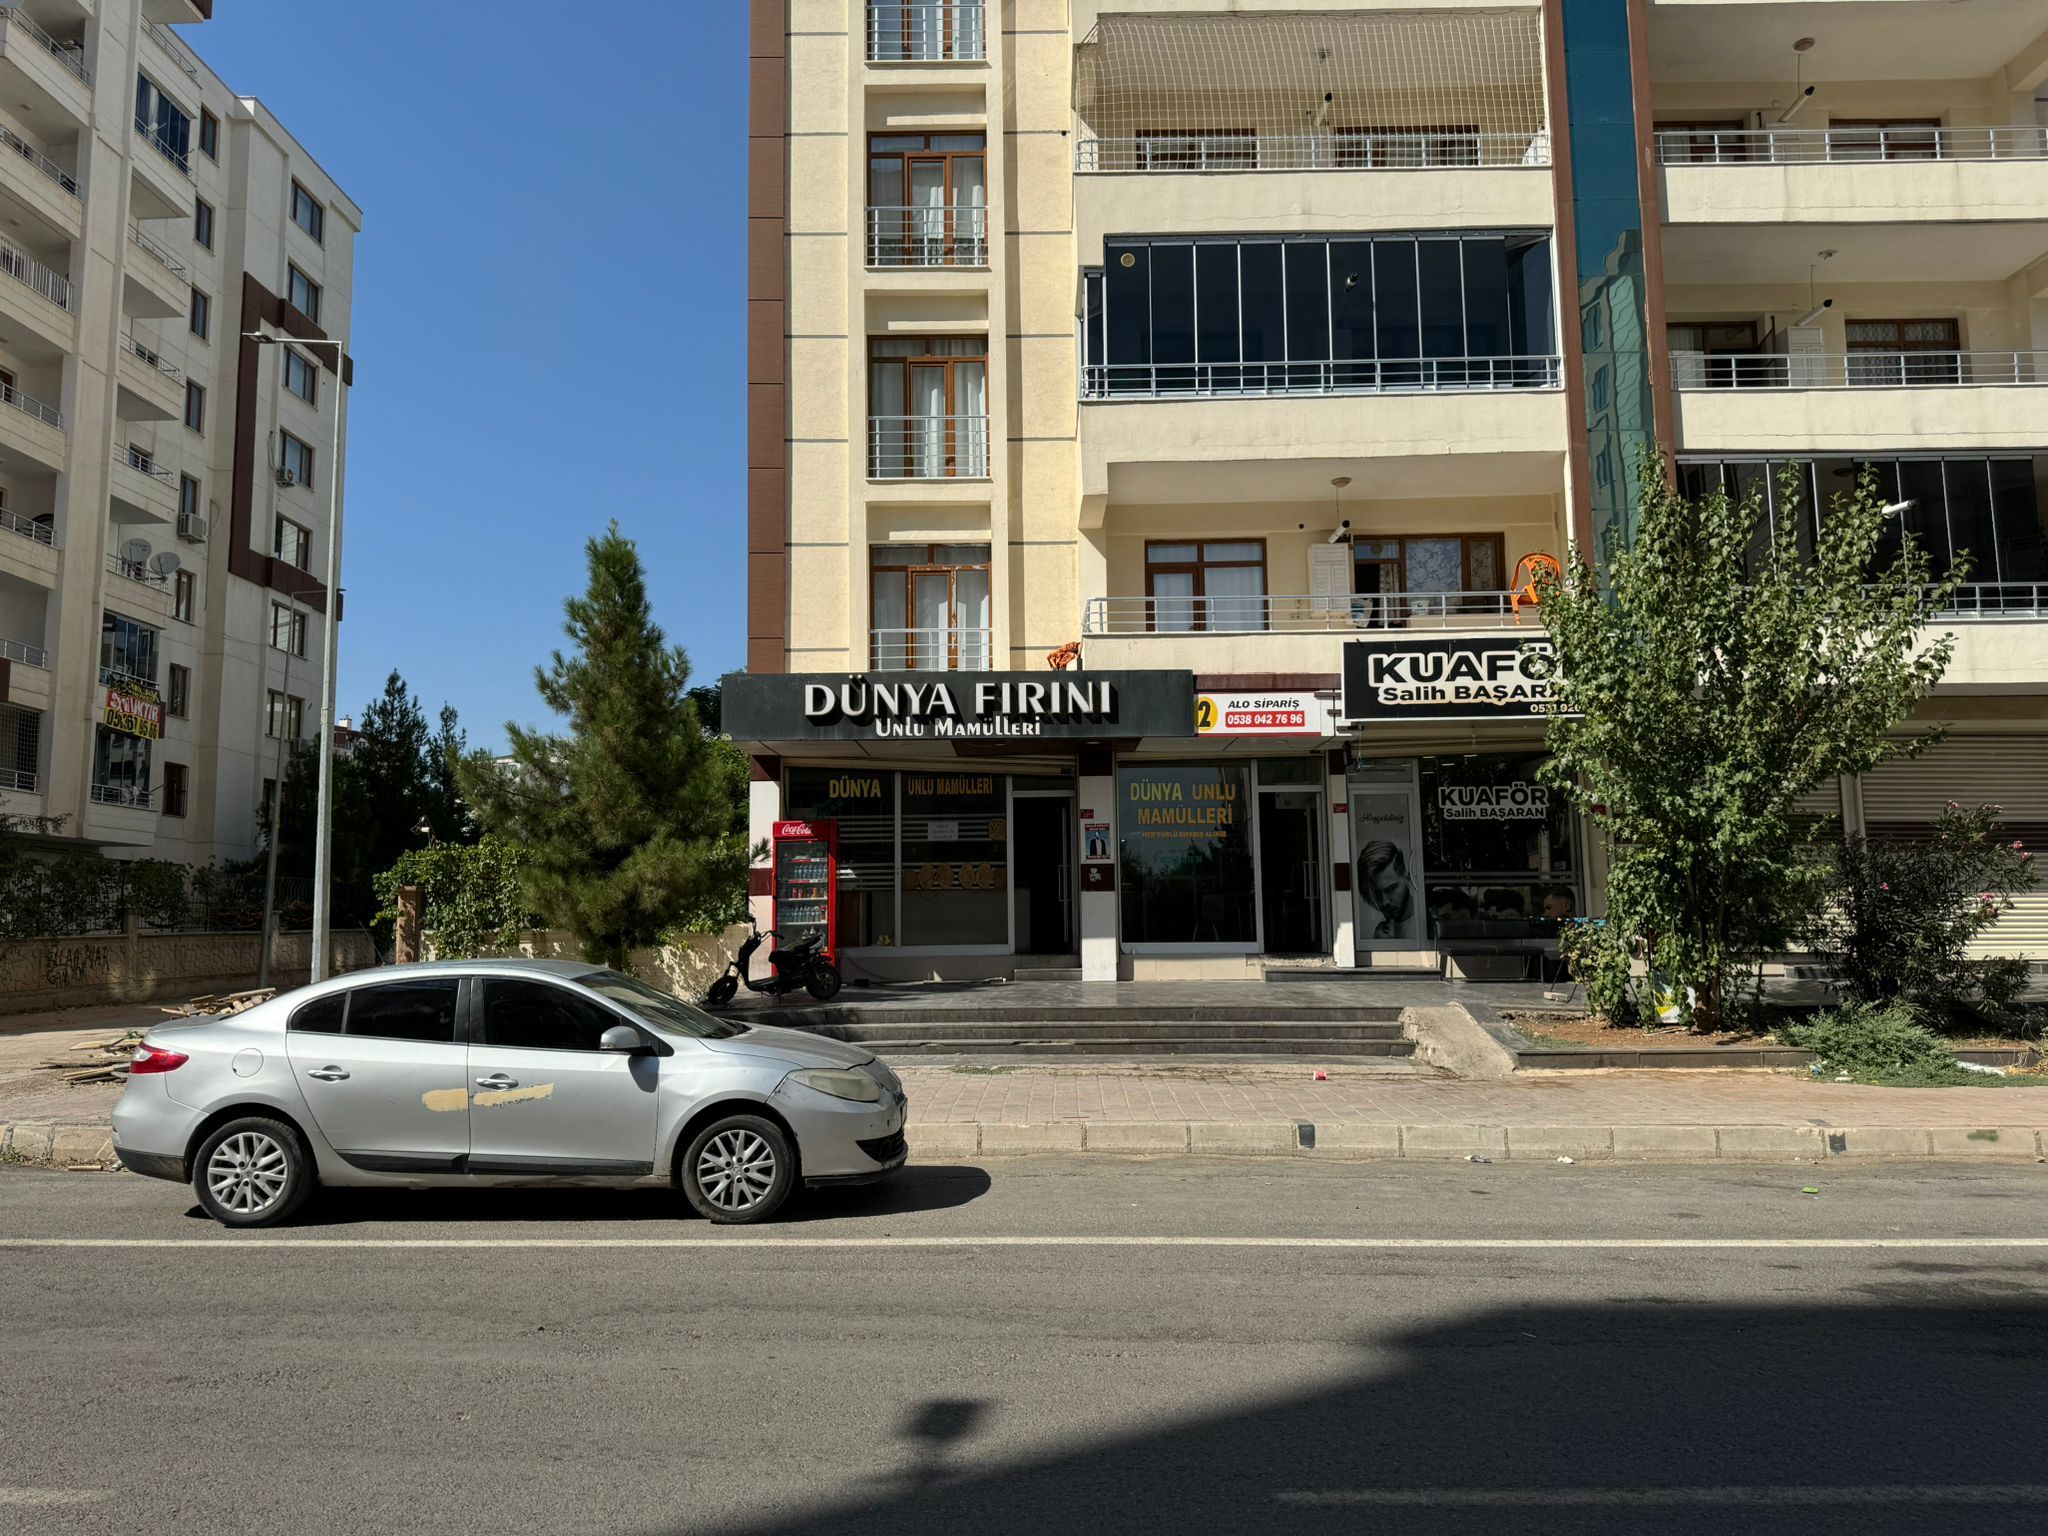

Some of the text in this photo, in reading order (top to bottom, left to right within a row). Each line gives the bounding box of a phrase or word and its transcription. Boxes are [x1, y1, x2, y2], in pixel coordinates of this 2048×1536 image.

[1371, 644, 1563, 685] KUAFÖ
[804, 674, 1111, 717] DÜNYA FIRINI
[1228, 697, 1300, 710] ALO SİPARİŞ
[1383, 685, 1446, 702] Salih
[1198, 700, 1211, 727] 2
[1227, 713, 1303, 725] 0538 042 76 96
[829, 775, 881, 798] DÜNYA
[908, 775, 993, 796] UNLU MAMÜLLERİ
[1130, 778, 1236, 801] DÜNYA UNLU
[1440, 782, 1548, 807] KUAFÖR
[1137, 804, 1233, 825] MAMÜLLERİ
[1445, 807, 1545, 821] Salih BAŞARAN
